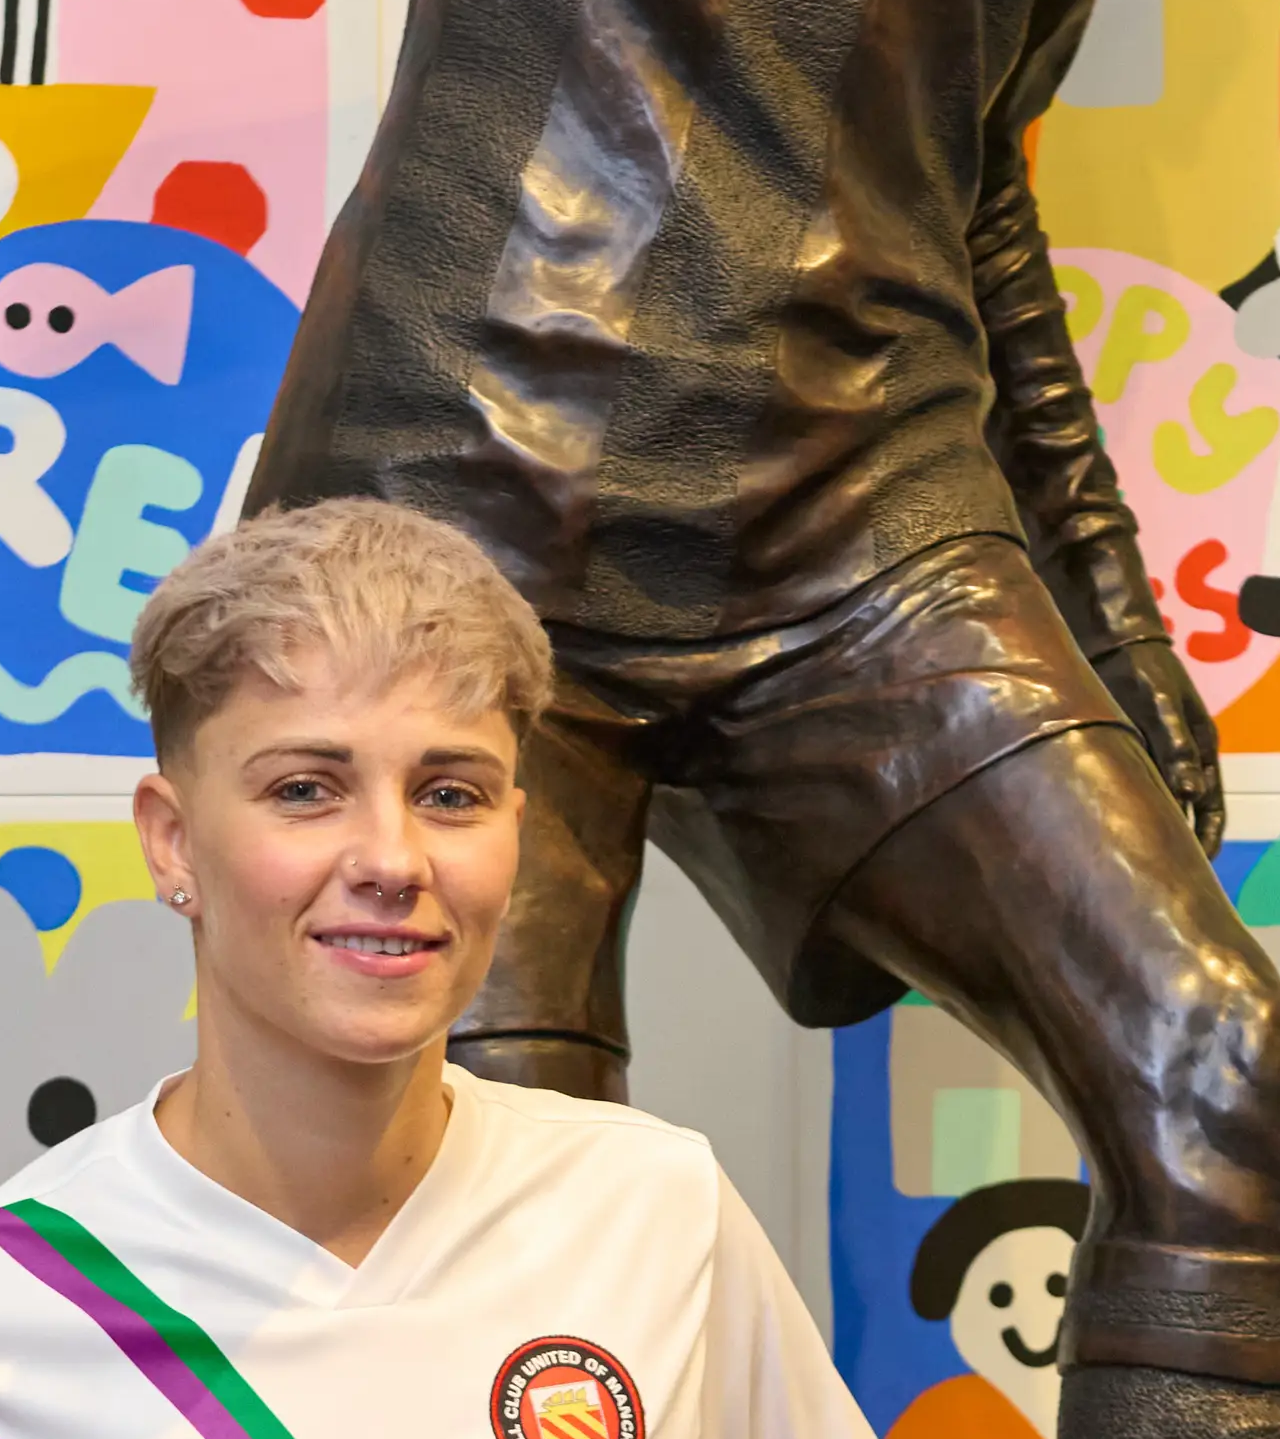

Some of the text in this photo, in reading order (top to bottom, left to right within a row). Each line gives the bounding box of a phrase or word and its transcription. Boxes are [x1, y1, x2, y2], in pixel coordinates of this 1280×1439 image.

[503, 1374, 528, 1420] CLUB
[519, 1349, 582, 1377] UNITED
[583, 1357, 609, 1378] OF
